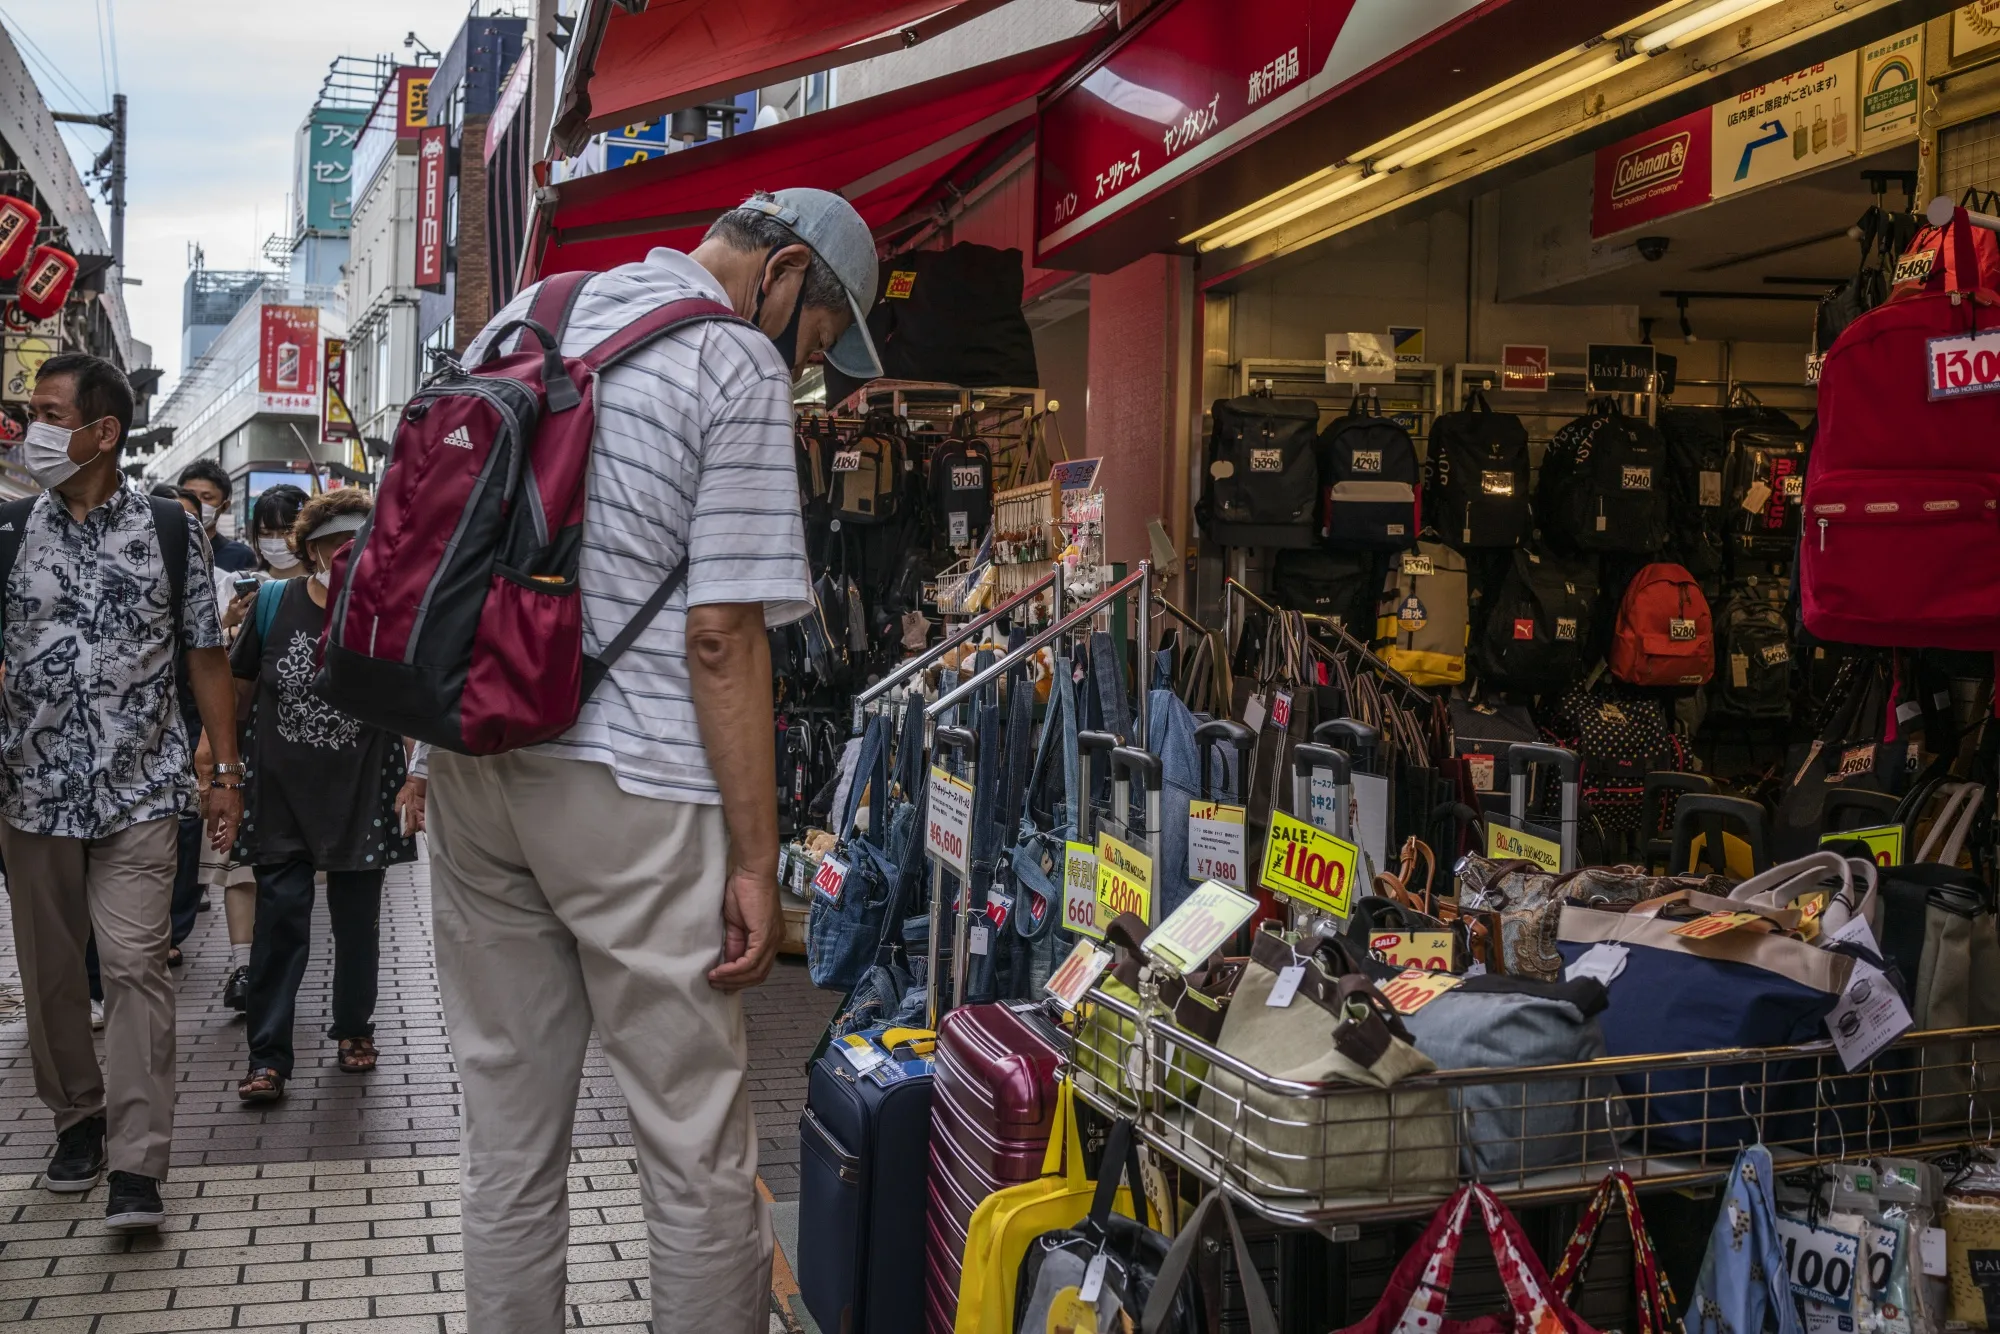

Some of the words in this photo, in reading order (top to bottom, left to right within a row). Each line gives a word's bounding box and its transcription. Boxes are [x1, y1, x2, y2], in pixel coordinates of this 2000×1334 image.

[1055, 193, 1077, 224] カバン
[1095, 150, 1141, 200] スーツケース
[1163, 92, 1220, 157] ヤングメンズ
[1248, 46, 1300, 106] 旅行用品
[1618, 152, 1670, 187] Coleman
[1612, 200, 1624, 212] The
[1624, 192, 1647, 207] Outdoor
[421, 159, 438, 276] GAME
[1896, 258, 1933, 280] 5480
[1336, 350, 1384, 368] FILA
[1593, 363, 1619, 378] EAST
[1630, 364, 1650, 379] BOY
[1935, 350, 2000, 390] 130
[1945, 386, 1960, 395] BAG
[1960, 383, 1983, 393] HOUSE
[443, 436, 474, 450] adidas
[833, 454, 858, 471] 4180
[1254, 456, 1279, 469] 5390
[1353, 457, 1380, 470] 4290
[952, 467, 981, 487] 3190
[1624, 473, 1650, 488] 5940
[1557, 622, 1577, 639] 7480
[1841, 757, 1871, 774] 4980
[929, 820, 963, 859] ¥6,600
[1271, 825, 1317, 845] SALE!
[1196, 857, 1237, 881] ¥7,980
[813, 861, 843, 897] 2400
[1374, 936, 1398, 948] SALE
[1431, 939, 1448, 949] えん
[1809, 1288, 1836, 1305] MASUYA
